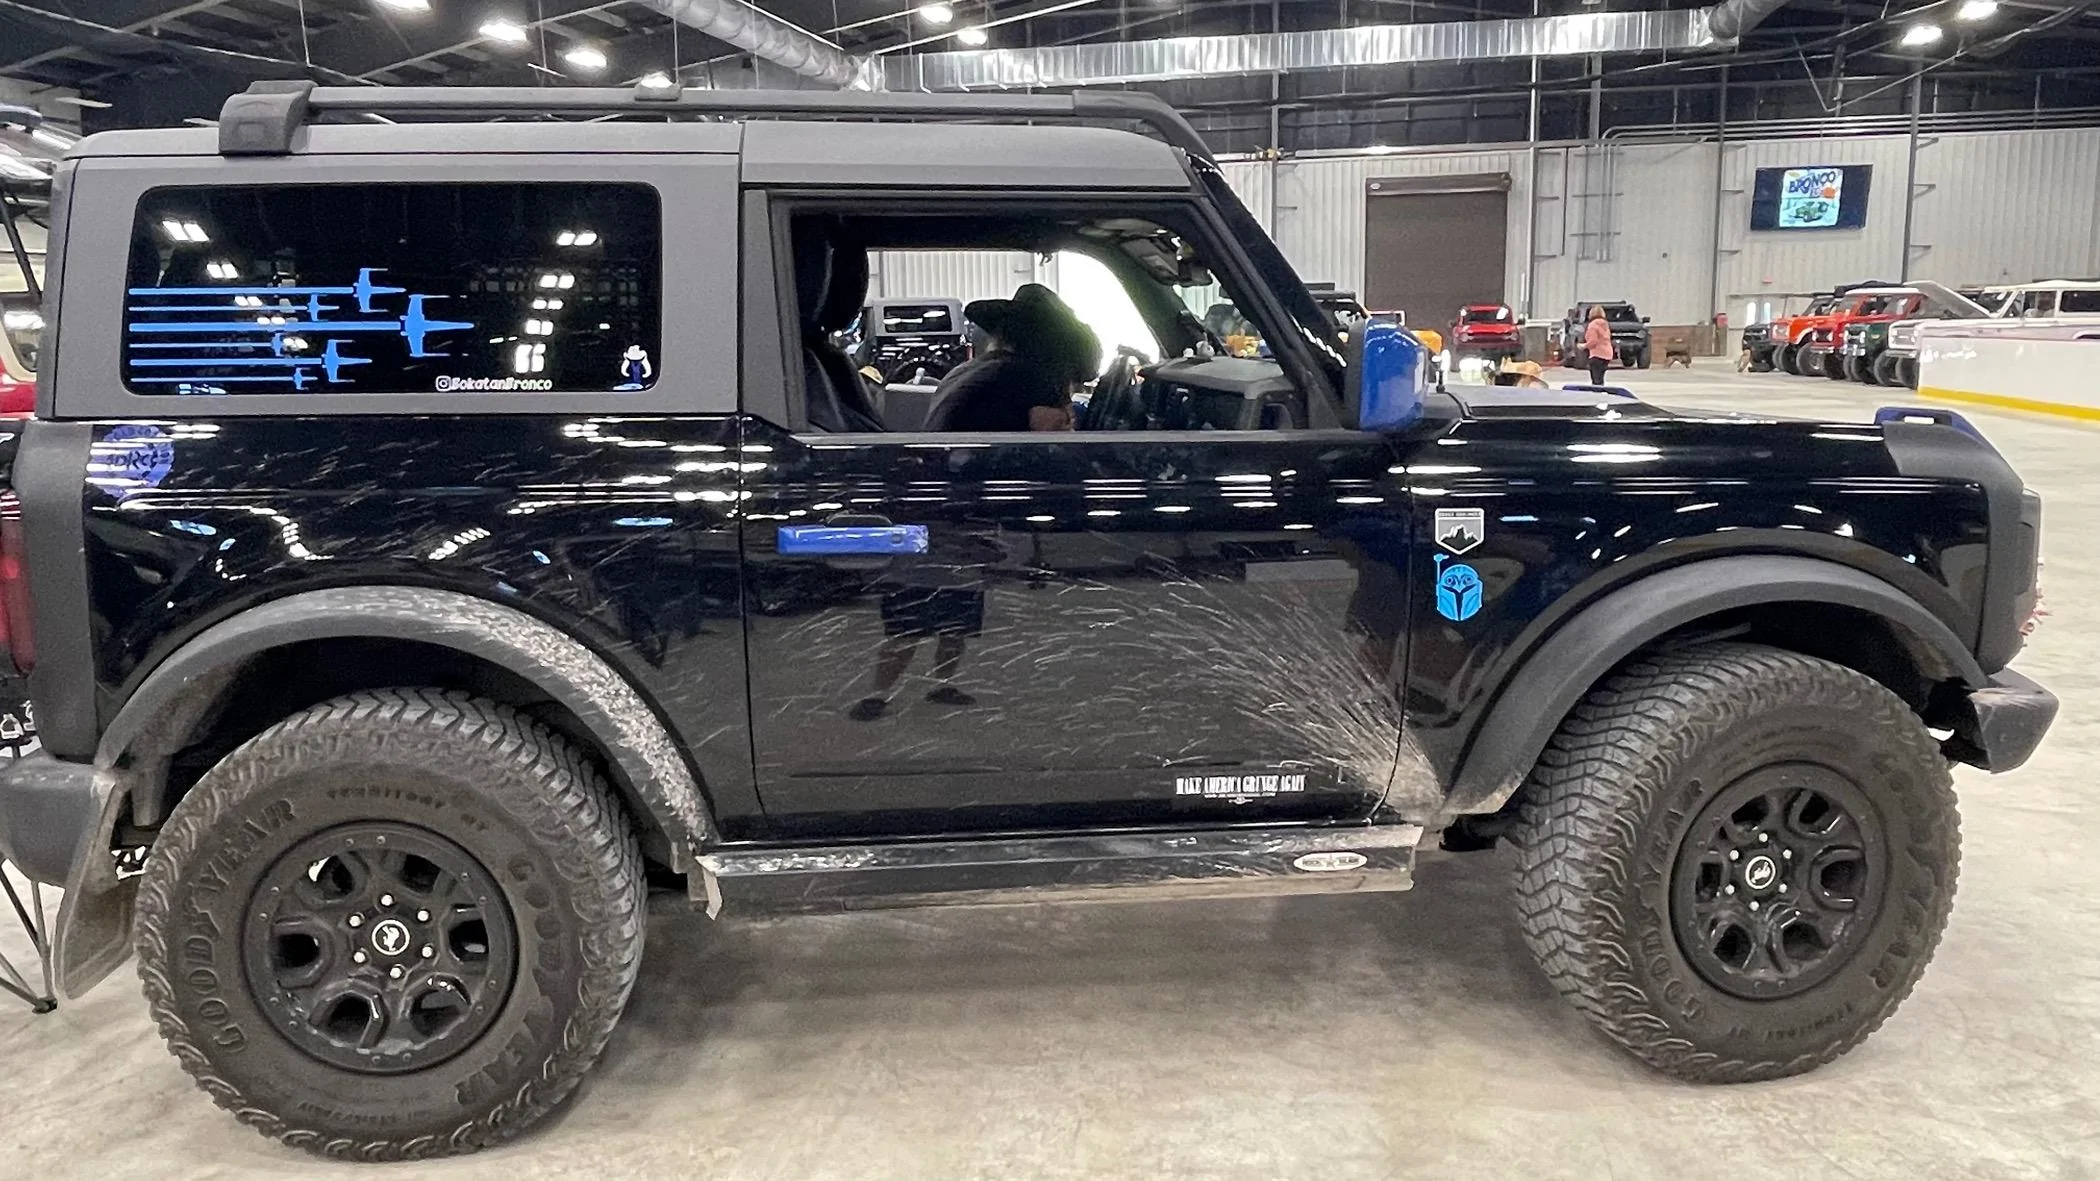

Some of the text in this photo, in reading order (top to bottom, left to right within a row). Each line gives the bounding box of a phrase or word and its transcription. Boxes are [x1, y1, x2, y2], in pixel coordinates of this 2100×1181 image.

[1788, 171, 1836, 194] BRONCO
[1204, 776, 1241, 793] AMERICA
[1281, 774, 1306, 792] AGAIN
